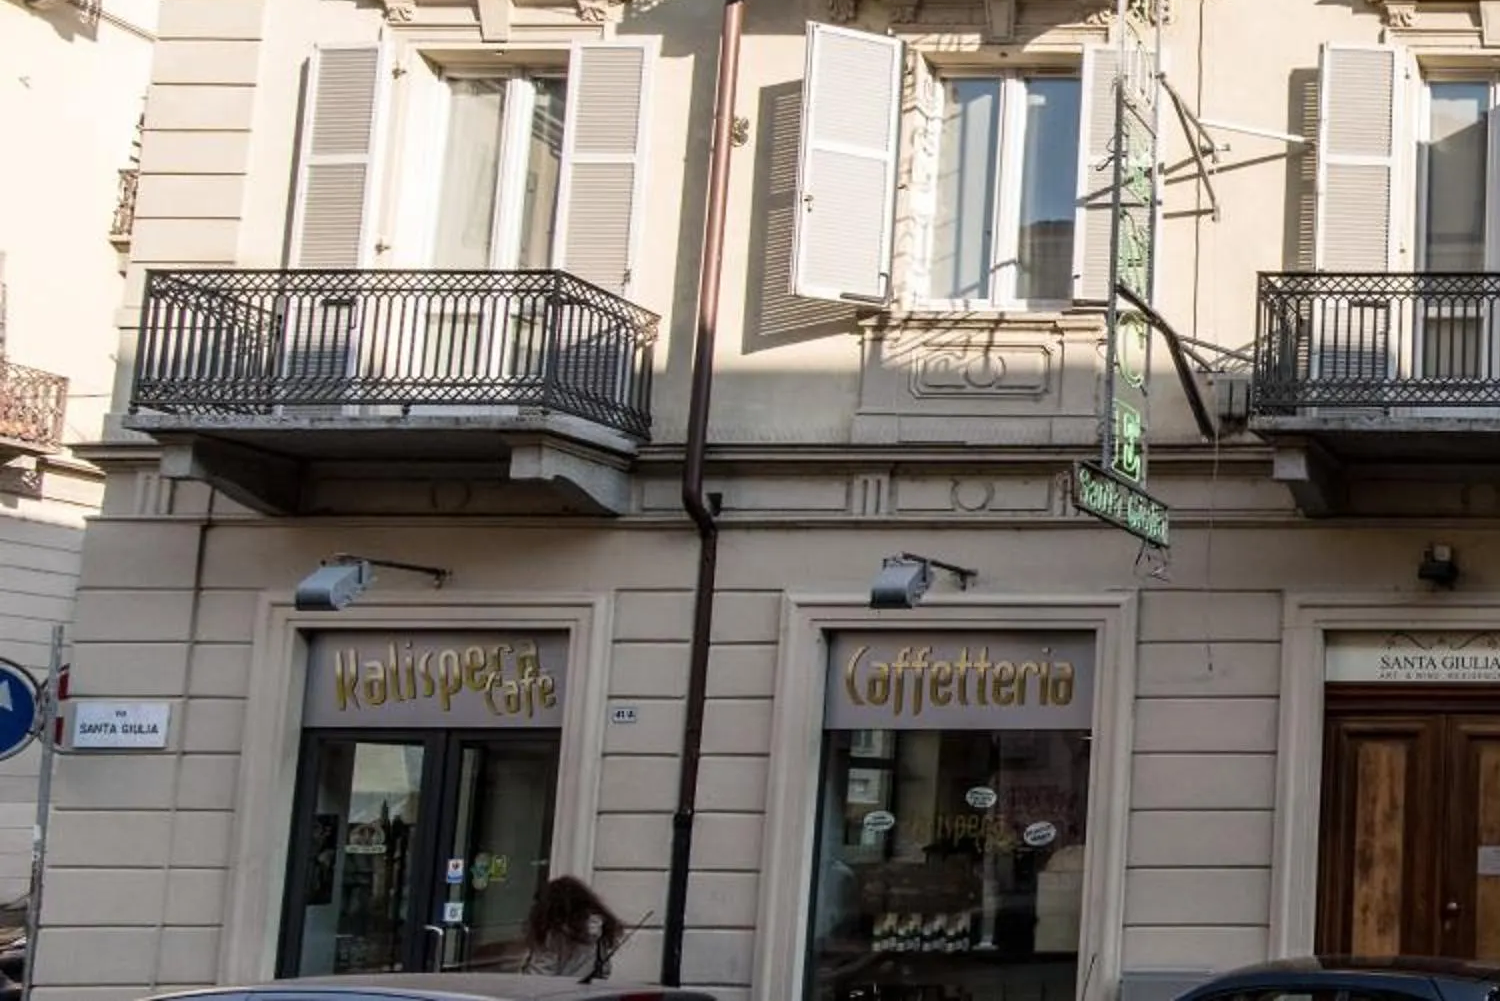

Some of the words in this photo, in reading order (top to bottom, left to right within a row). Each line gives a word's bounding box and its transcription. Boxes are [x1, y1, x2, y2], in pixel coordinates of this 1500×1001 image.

[334, 639, 542, 711] Kalispera
[845, 646, 1074, 716] Caffetteria
[1380, 656, 1437, 670] SANTA
[80, 722, 117, 734] SANTA
[121, 722, 159, 734] GIULIA
